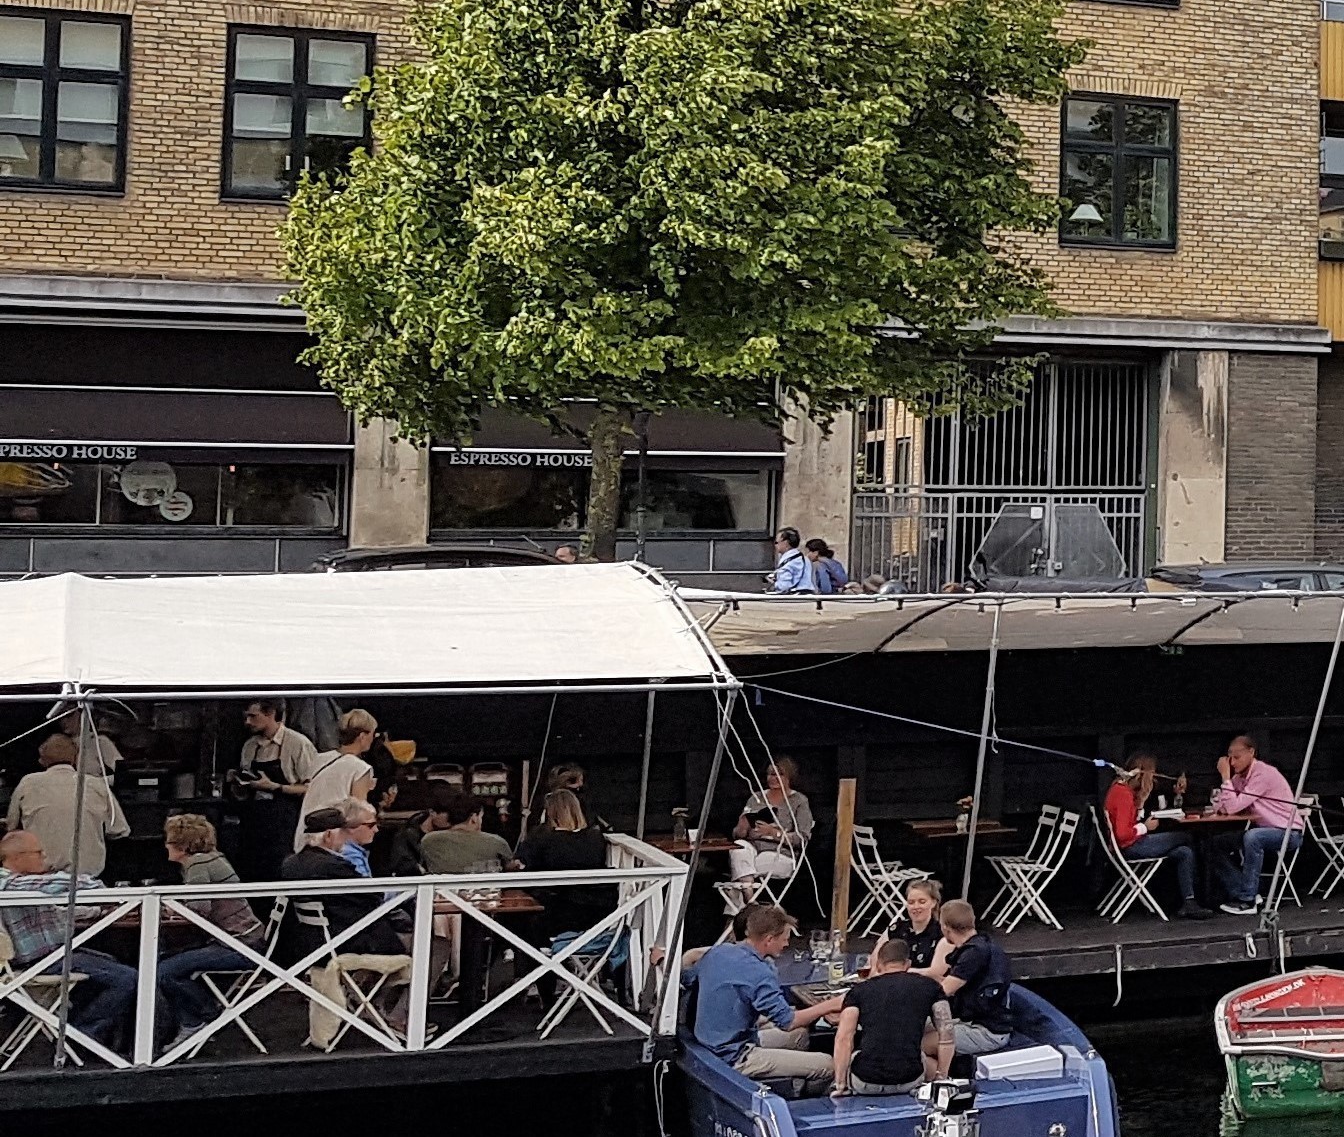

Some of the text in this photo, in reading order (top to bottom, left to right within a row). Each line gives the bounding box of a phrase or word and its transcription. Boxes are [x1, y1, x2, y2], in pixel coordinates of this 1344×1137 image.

[72, 446, 137, 459] HOUSE
[450, 453, 593, 467] ESPRESSO HOUSE
